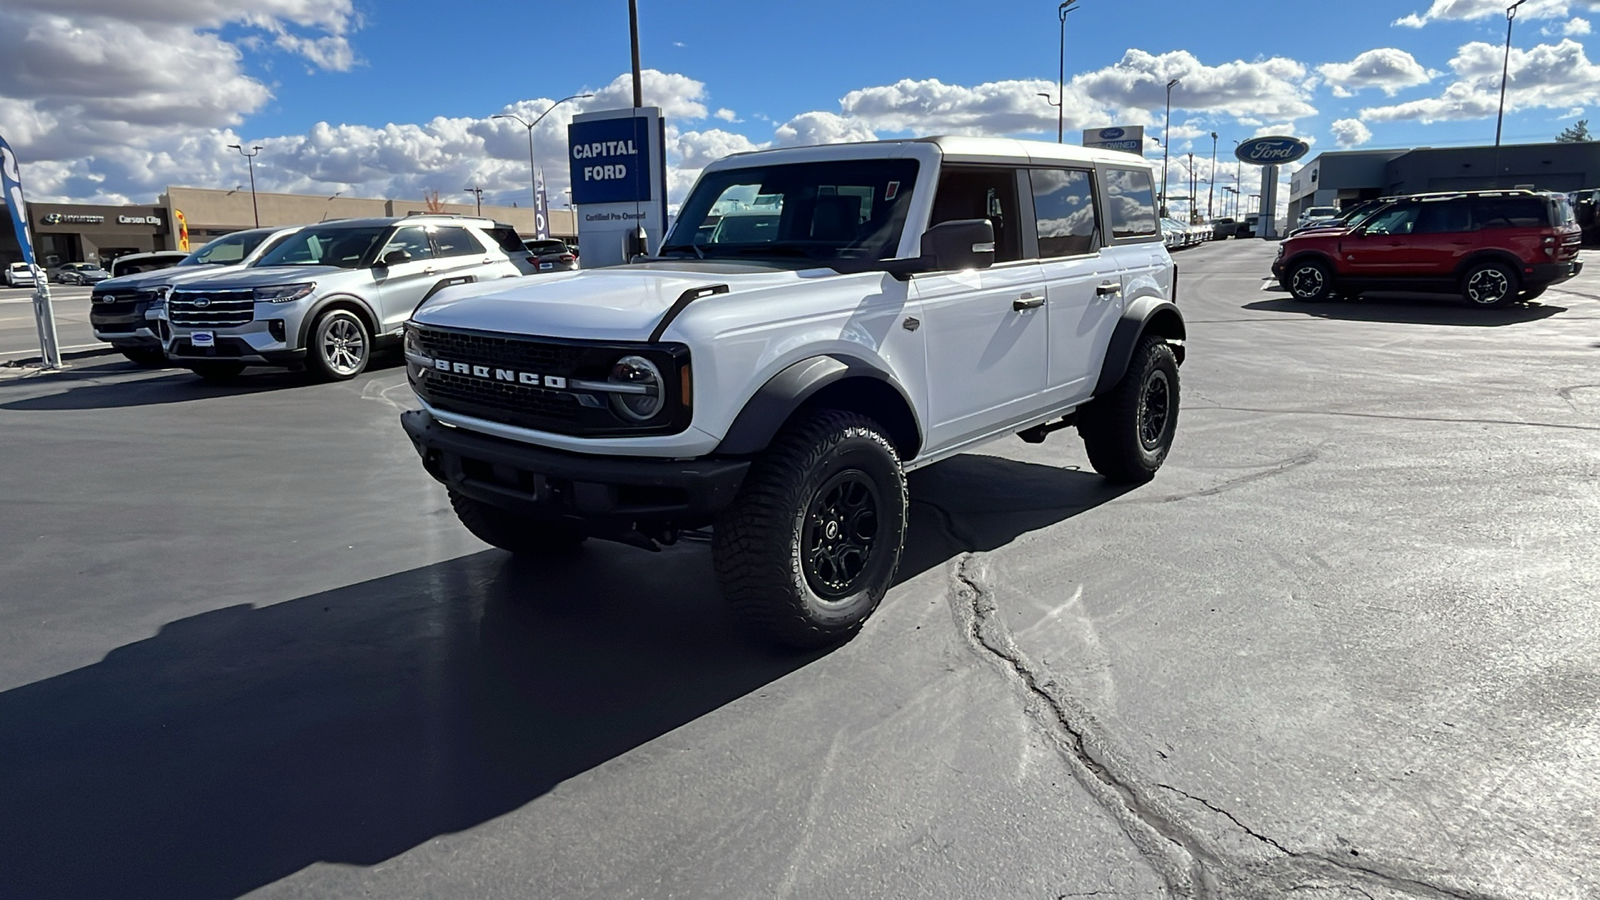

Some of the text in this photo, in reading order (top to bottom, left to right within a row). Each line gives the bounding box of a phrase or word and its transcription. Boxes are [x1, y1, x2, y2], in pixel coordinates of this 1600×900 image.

[573, 140, 638, 159] CAPITAL
[1250, 141, 1294, 159] Ford
[584, 164, 627, 181] FORD
[118, 215, 161, 225] Carson City
[585, 213, 610, 221] Certified
[435, 359, 566, 388] BRONCO
